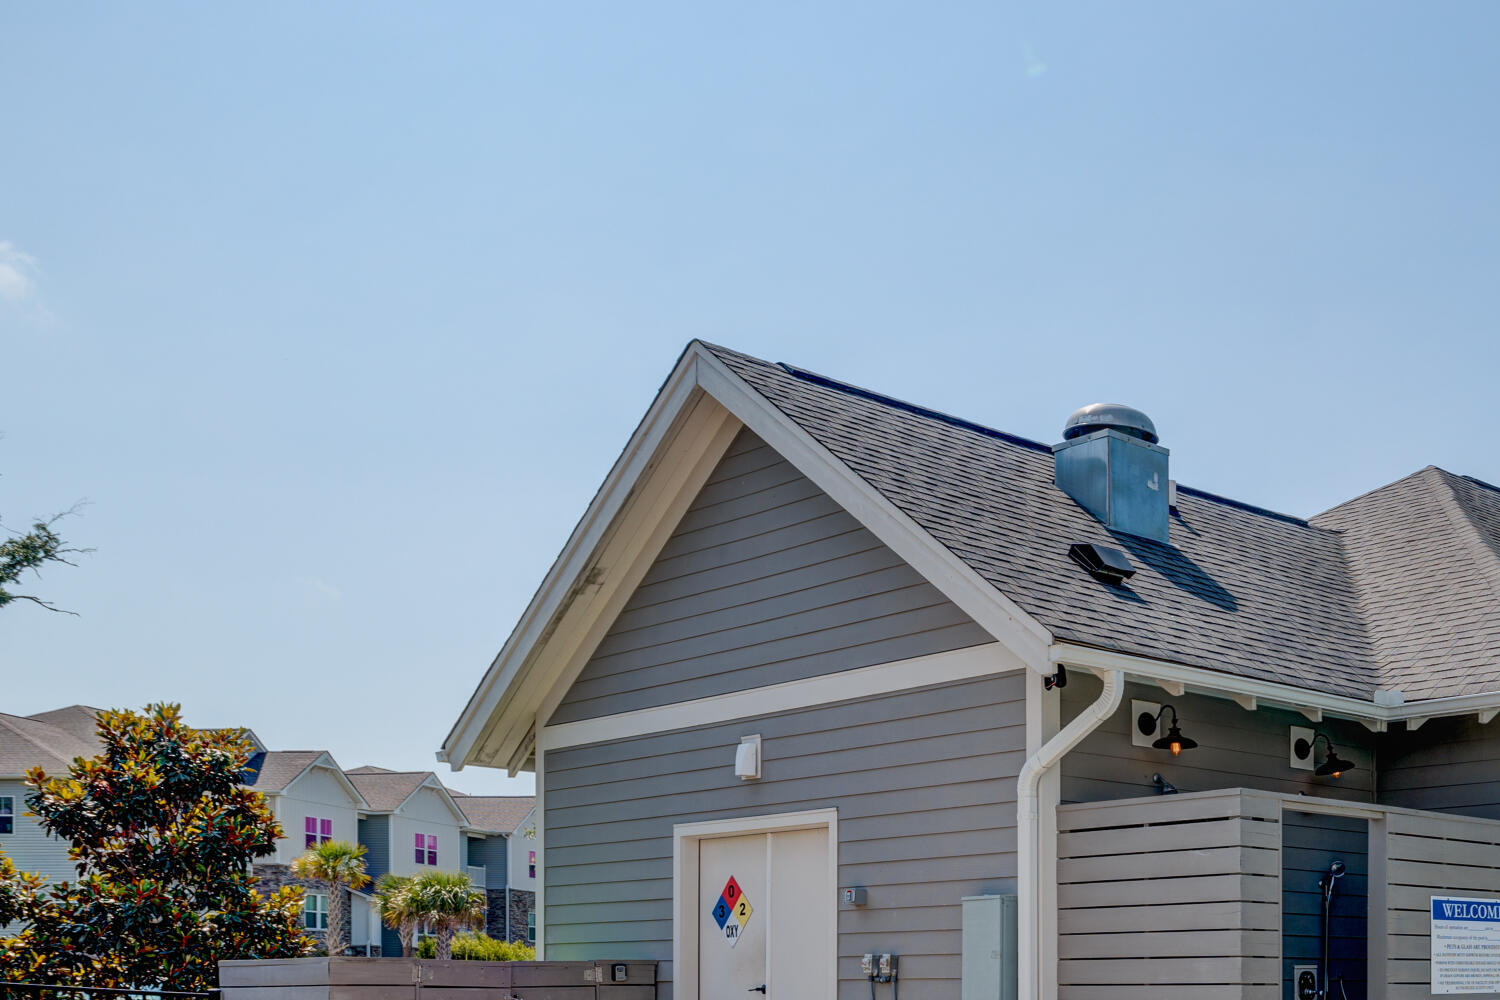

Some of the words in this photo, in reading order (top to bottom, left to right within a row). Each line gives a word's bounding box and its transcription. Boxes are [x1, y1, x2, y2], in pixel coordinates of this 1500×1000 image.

[728, 885, 735, 898] 0
[718, 905, 725, 918] 3
[739, 903, 746, 916] 2
[726, 924, 739, 938] OXY
